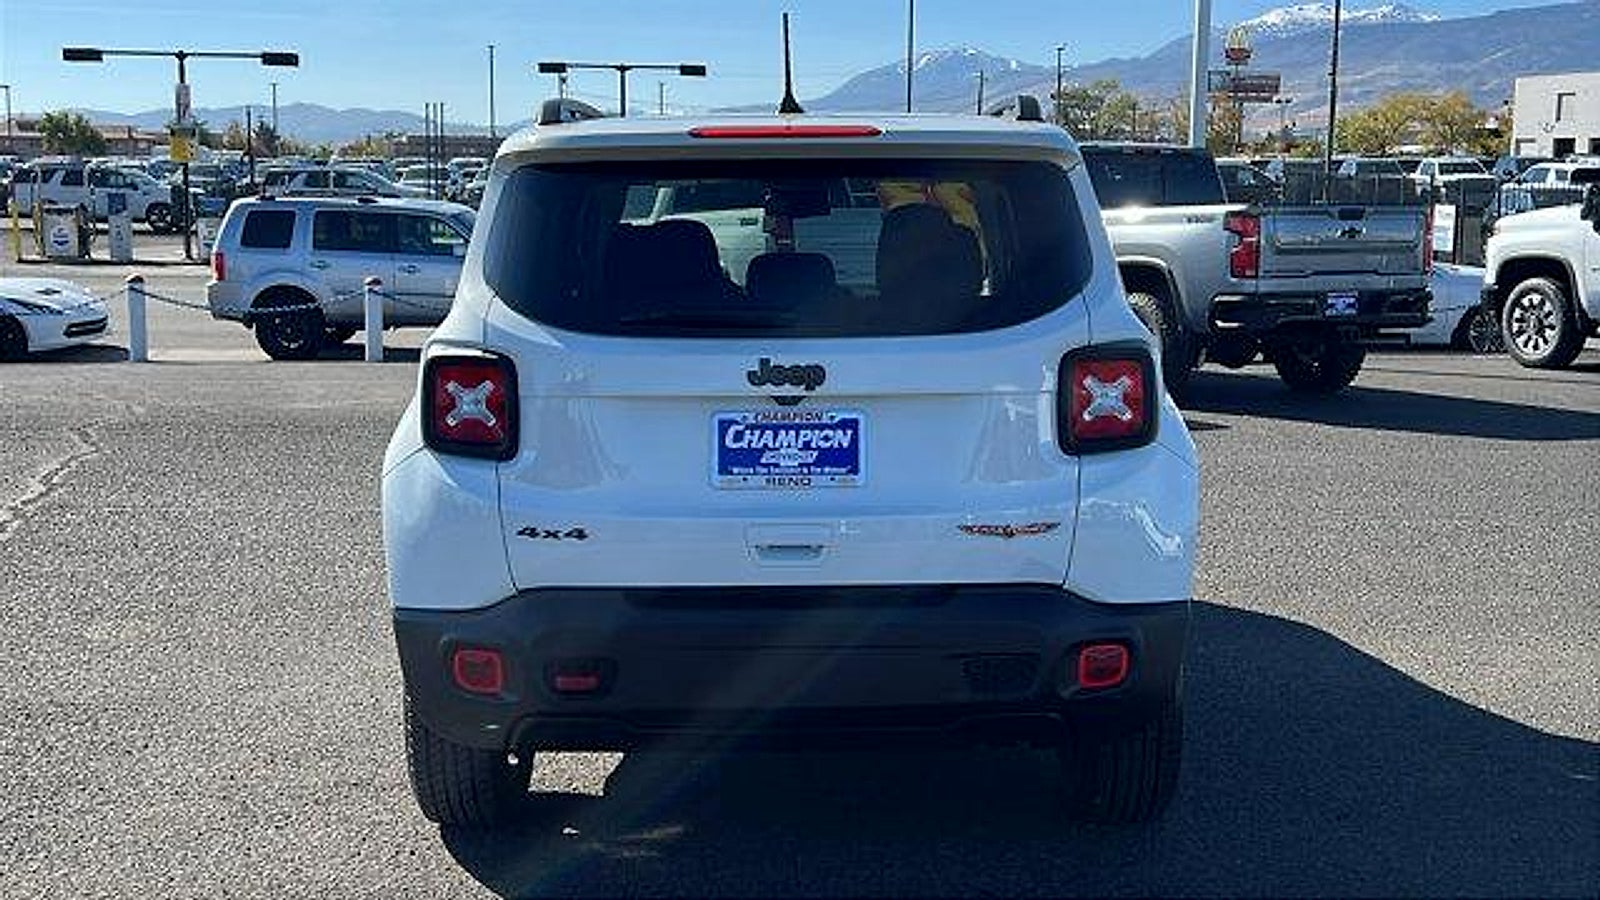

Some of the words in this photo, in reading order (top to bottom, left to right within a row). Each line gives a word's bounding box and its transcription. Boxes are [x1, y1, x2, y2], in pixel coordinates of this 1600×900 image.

[747, 358, 826, 391] Jeep
[725, 425, 853, 448] CHAMPION
[517, 527, 588, 540] 4x4
